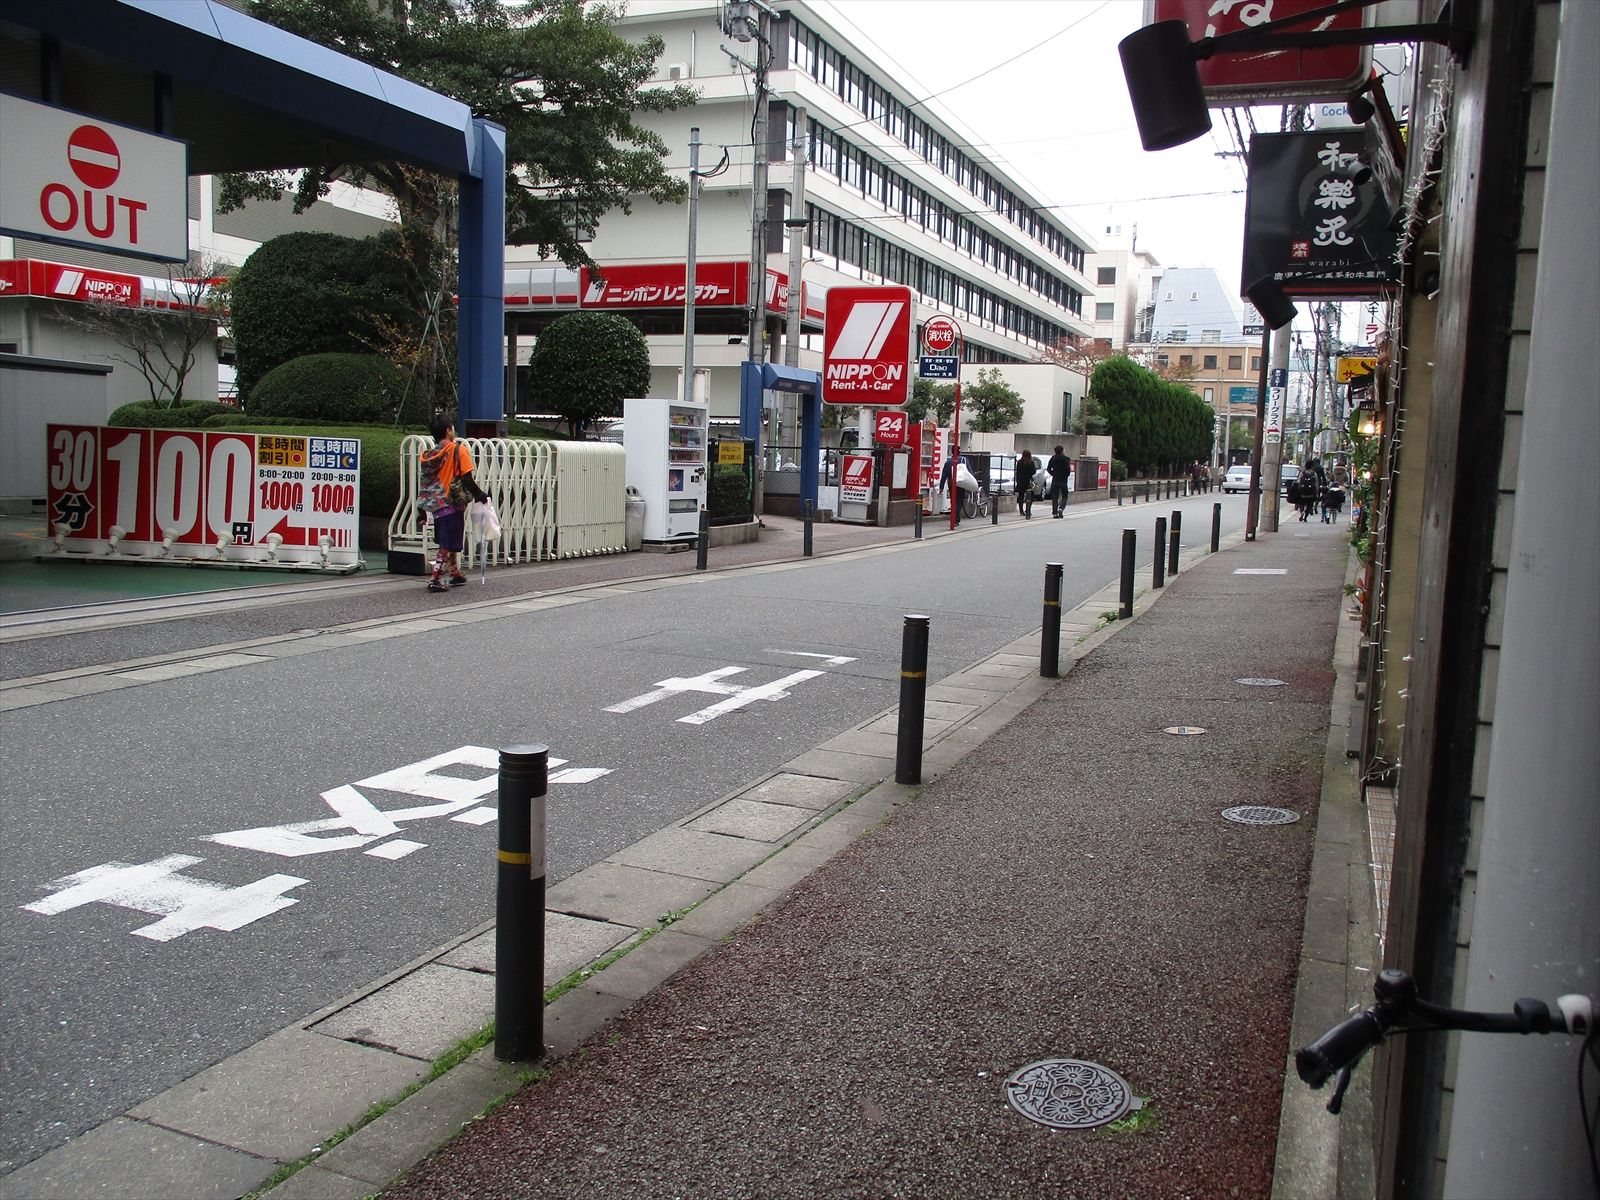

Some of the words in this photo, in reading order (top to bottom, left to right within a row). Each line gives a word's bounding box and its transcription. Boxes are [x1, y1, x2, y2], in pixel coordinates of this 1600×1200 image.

[40, 182, 147, 244] OUT
[1309, 258, 1350, 267] warabi
[85, 279, 131, 296] NIPPON
[606, 284, 729, 303] ニッポンレンタカー
[929, 330, 952, 341] 消火栓
[827, 363, 902, 380] NIPPON
[830, 380, 893, 391] Rent-A-Car
[878, 417, 903, 431] 24
[259, 436, 305, 452] 長時間
[311, 439, 356, 454] 長時間
[51, 430, 97, 491] 30
[259, 451, 289, 465] 割引
[311, 453, 341, 468] 割引
[52, 493, 96, 531] 分
